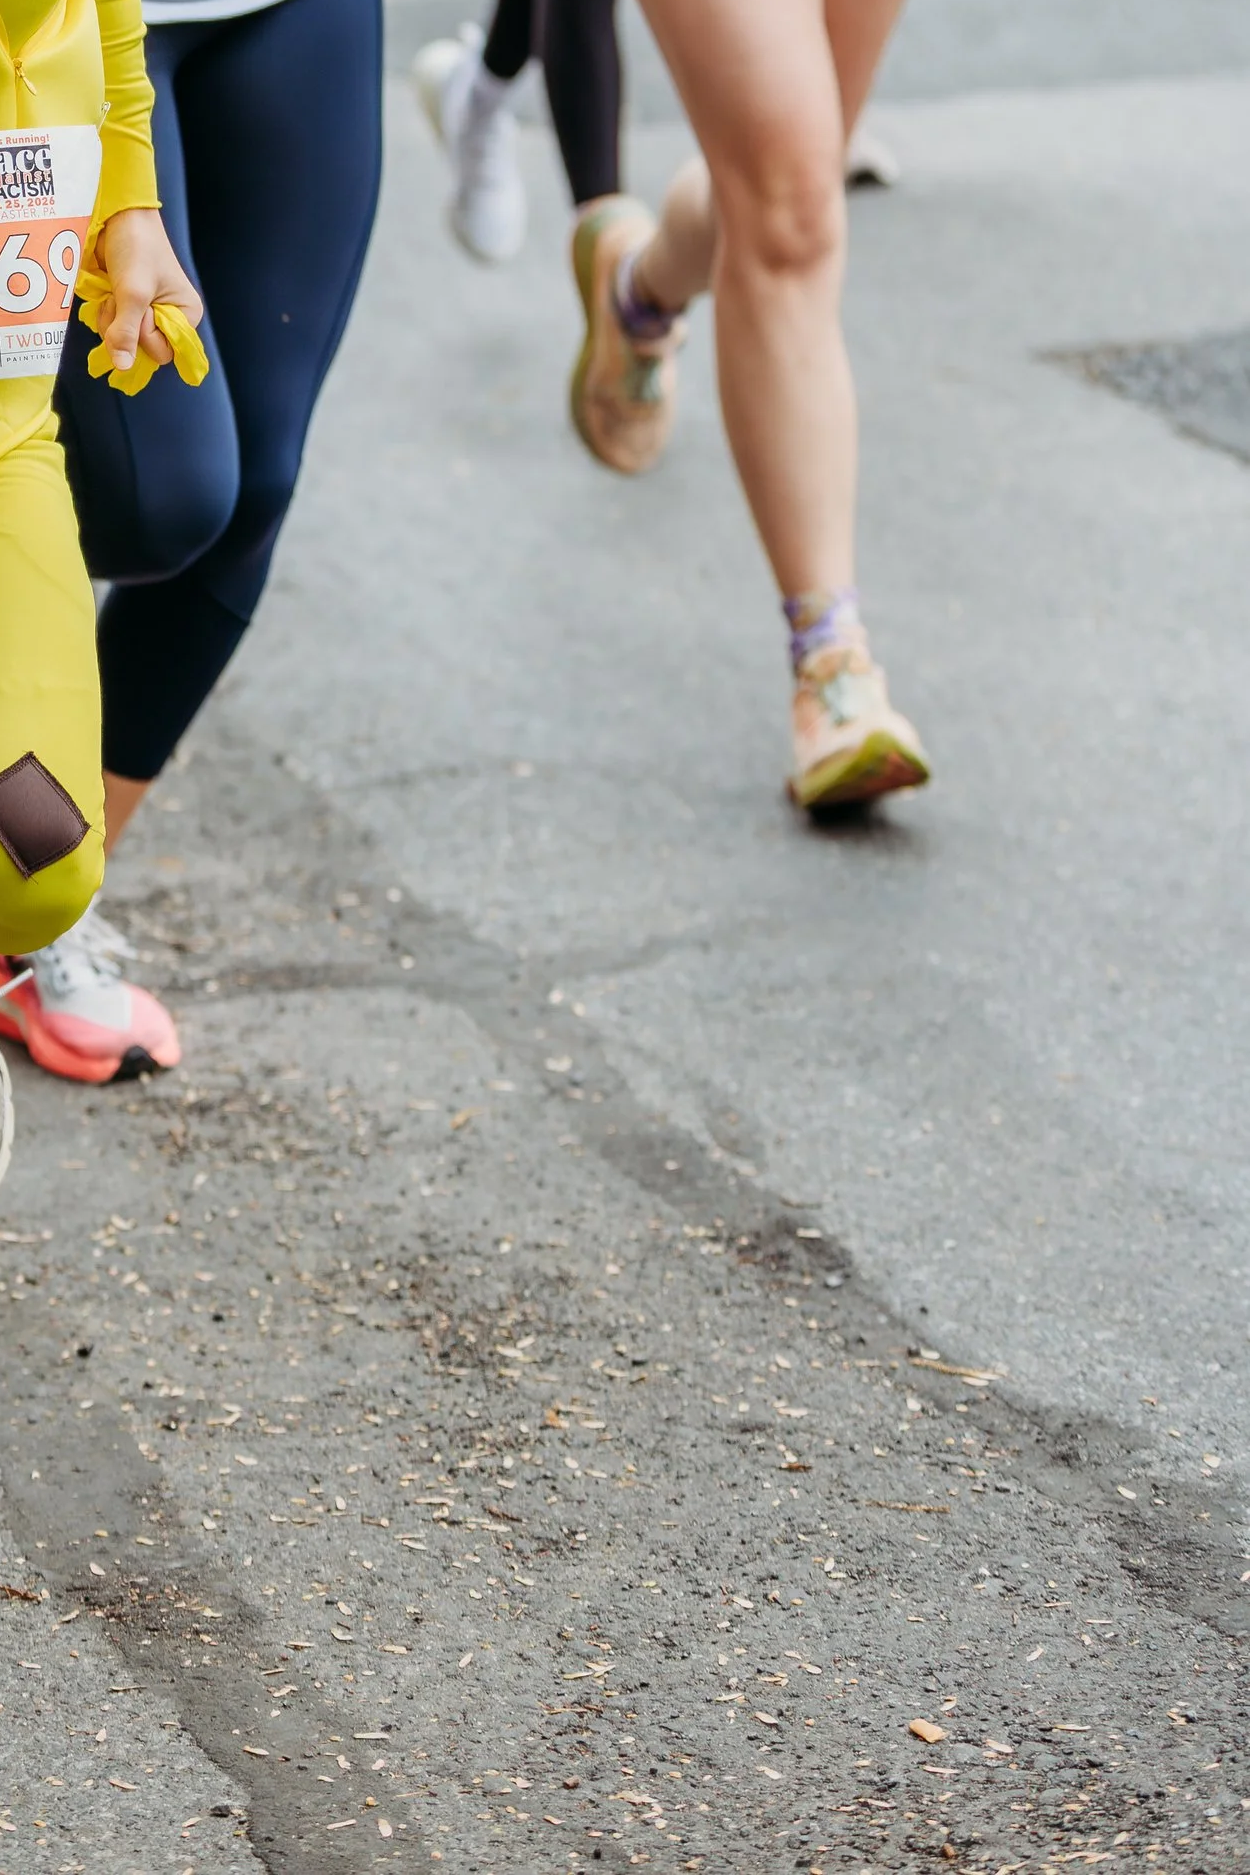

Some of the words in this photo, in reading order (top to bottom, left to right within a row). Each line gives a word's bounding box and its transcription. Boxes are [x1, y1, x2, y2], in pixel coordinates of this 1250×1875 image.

[6, 134, 50, 145] Running!
[5, 199, 24, 209] 25,
[27, 196, 55, 207] 2026
[43, 207, 56, 217] PA
[6, 354, 51, 363] PAINTING
